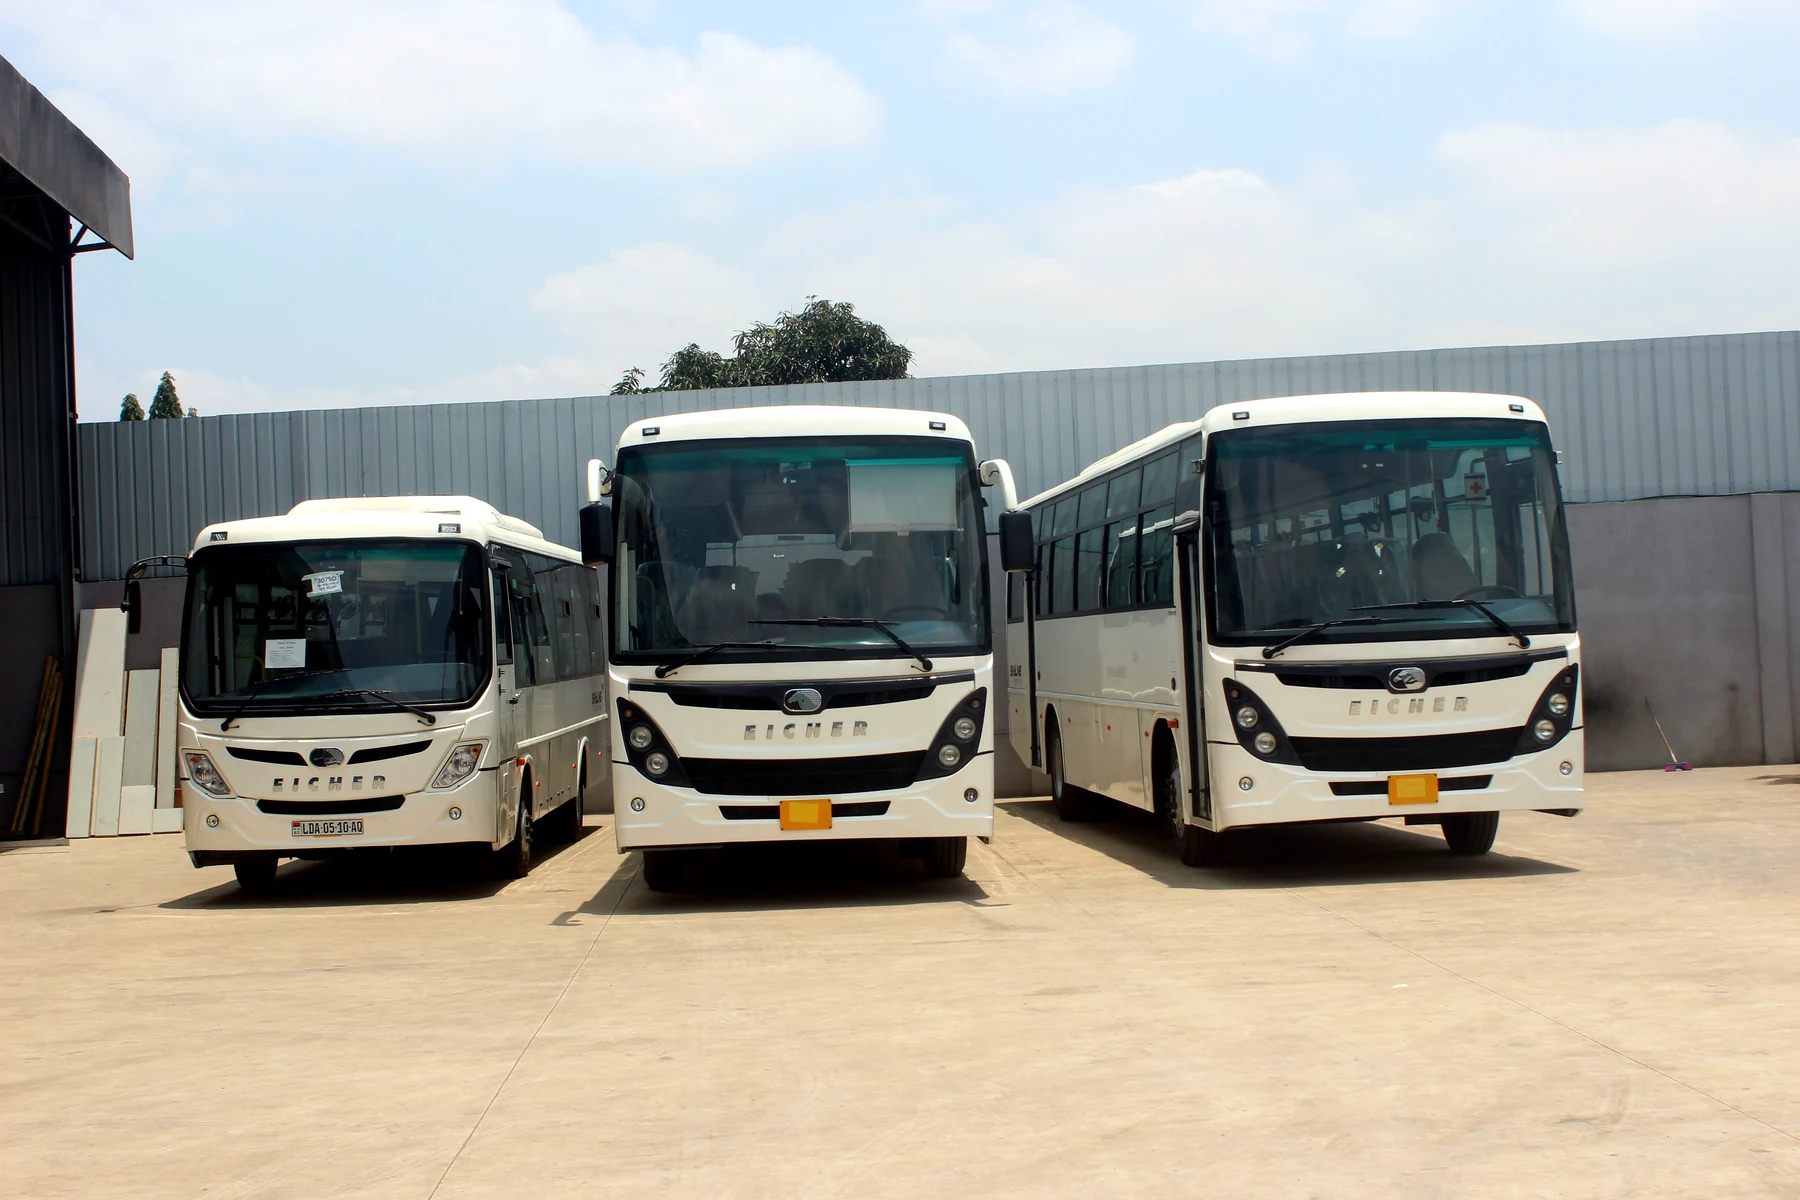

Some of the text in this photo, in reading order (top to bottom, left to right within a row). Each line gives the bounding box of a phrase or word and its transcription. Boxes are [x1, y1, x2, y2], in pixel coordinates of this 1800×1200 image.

[1349, 696, 1468, 715] EICHER
[744, 720, 867, 740] EICHER
[273, 775, 386, 792] EICHER
